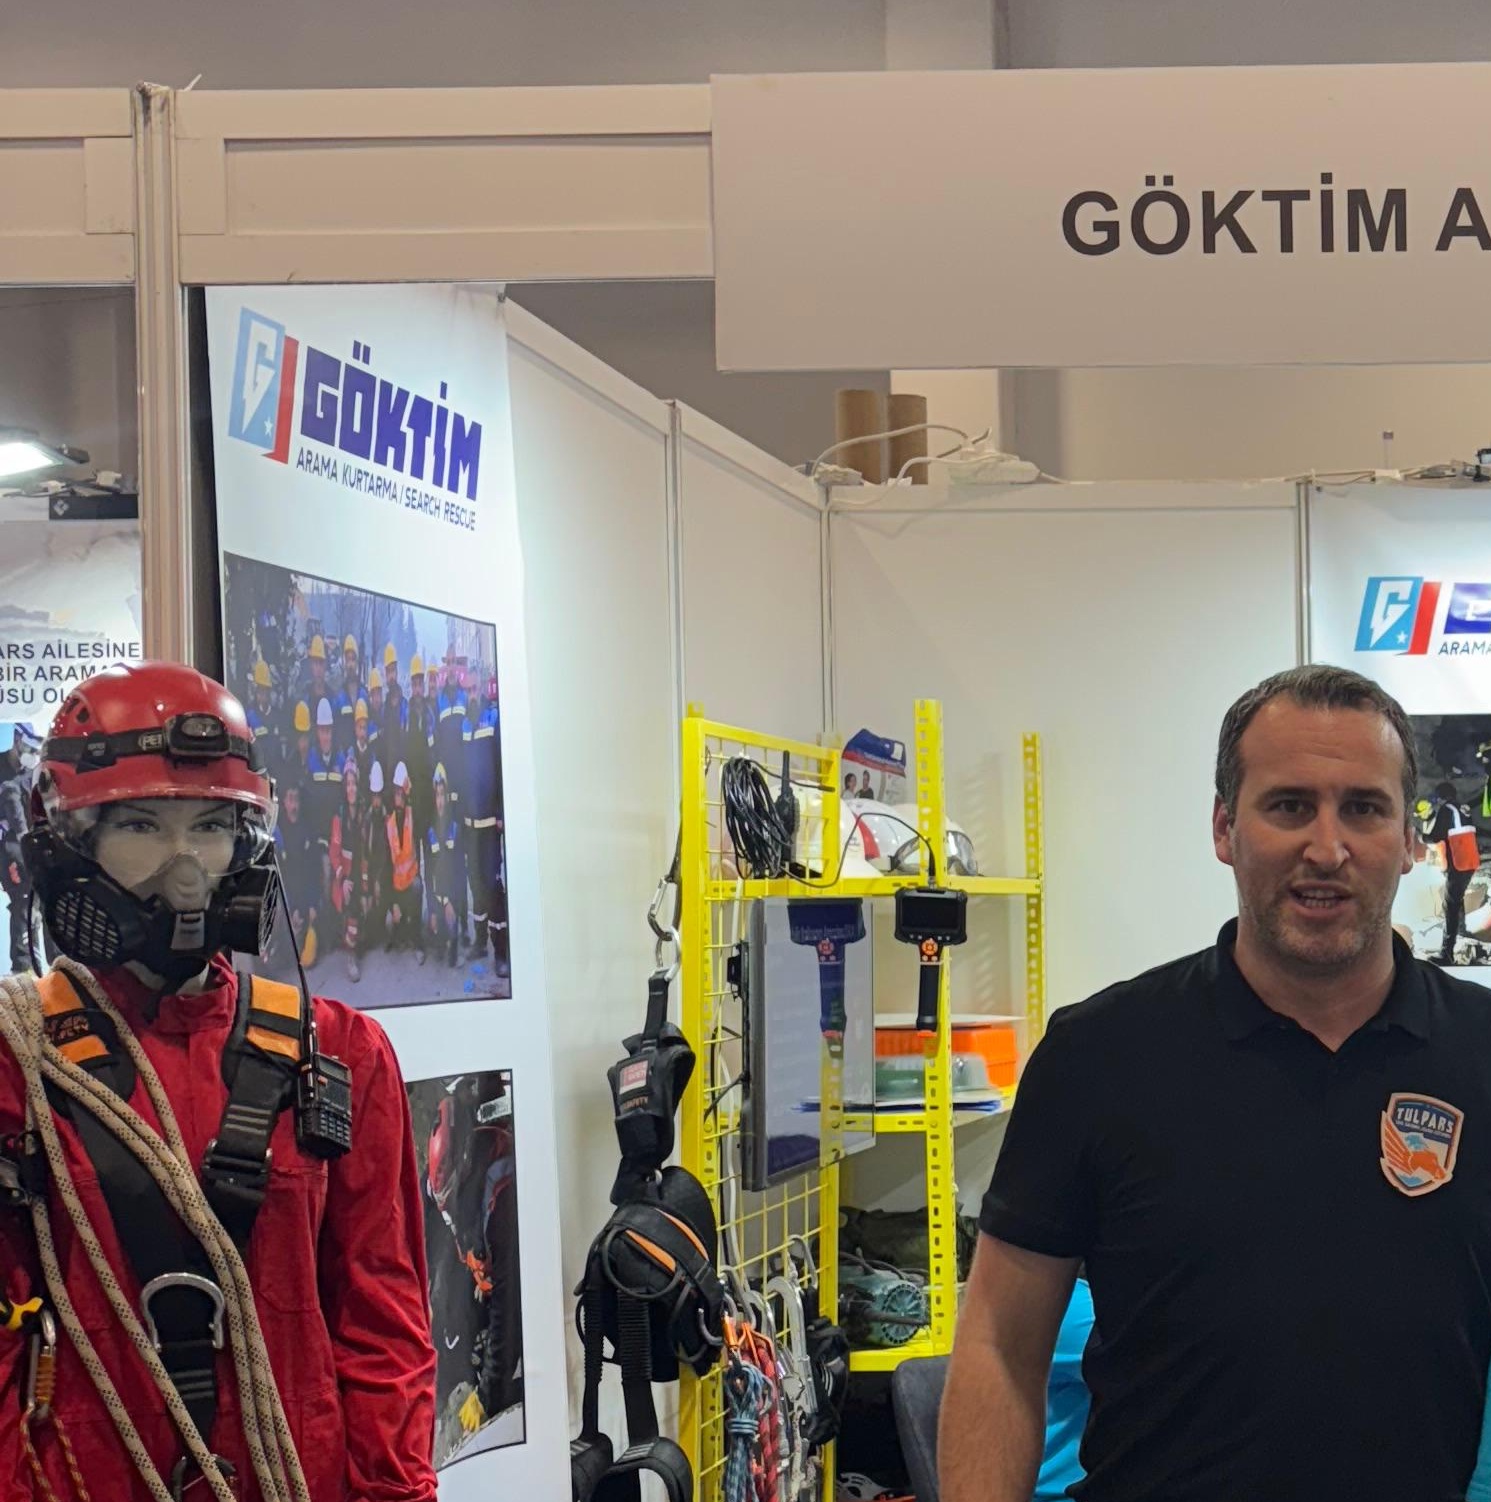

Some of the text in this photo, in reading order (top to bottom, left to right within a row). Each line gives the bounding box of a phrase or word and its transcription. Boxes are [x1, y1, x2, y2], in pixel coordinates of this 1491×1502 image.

[1061, 173, 1408, 255] GÖKTİM
[301, 340, 482, 501] GÖKTİM
[296, 447, 338, 483] ARAMA
[343, 462, 398, 504] KURTARMA
[405, 487, 440, 518] SEARCH
[443, 501, 476, 531] RESCUE
[42, 639, 140, 659] AİLESİNE
[1397, 1107, 1454, 1133] TULPARS
